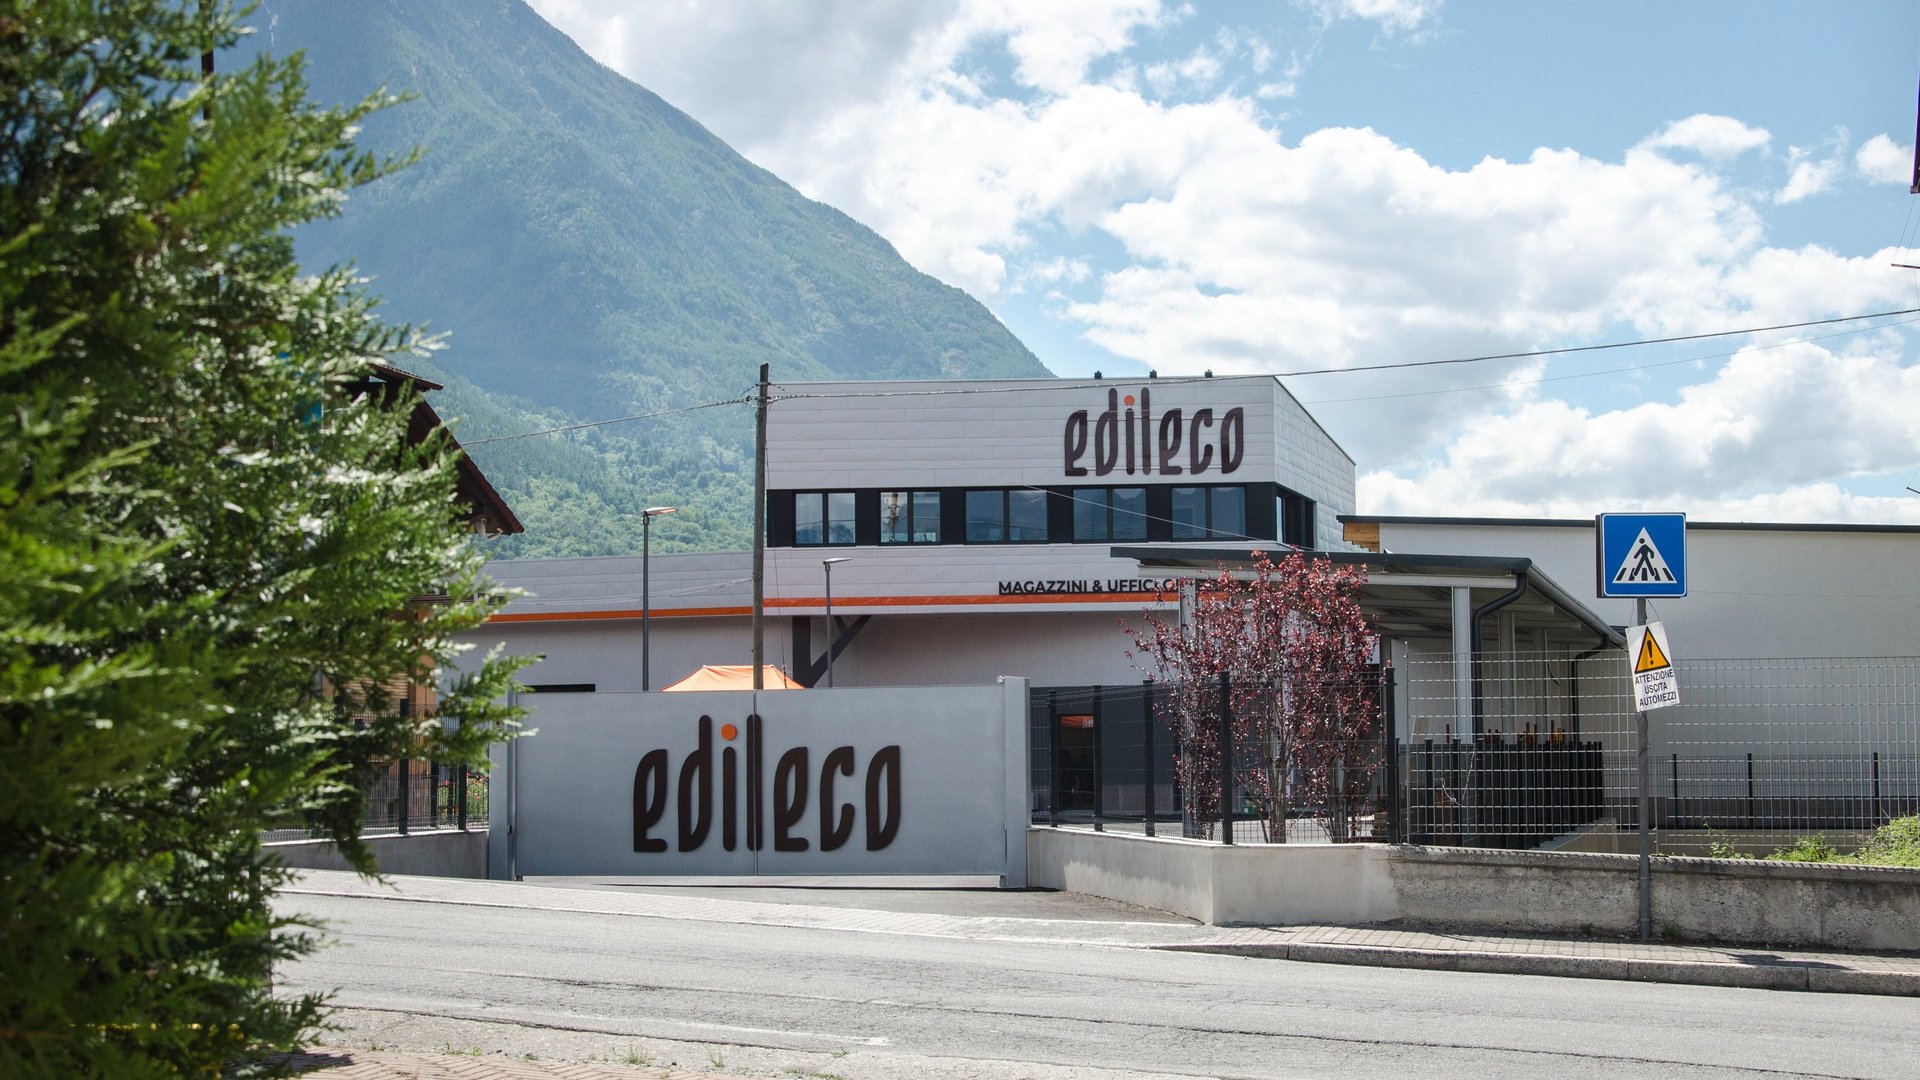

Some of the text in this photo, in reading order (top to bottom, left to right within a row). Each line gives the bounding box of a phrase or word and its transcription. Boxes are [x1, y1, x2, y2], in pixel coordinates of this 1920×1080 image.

[1064, 387, 1244, 477] edileco
[999, 579, 1087, 594] MAGAZZINI
[1092, 579, 1102, 592] &
[1635, 668, 1674, 685] ATTENZIONE
[1644, 682, 1668, 695] USCITA
[1639, 691, 1677, 707] AUTOMEZZI
[633, 714, 900, 852] edileco
